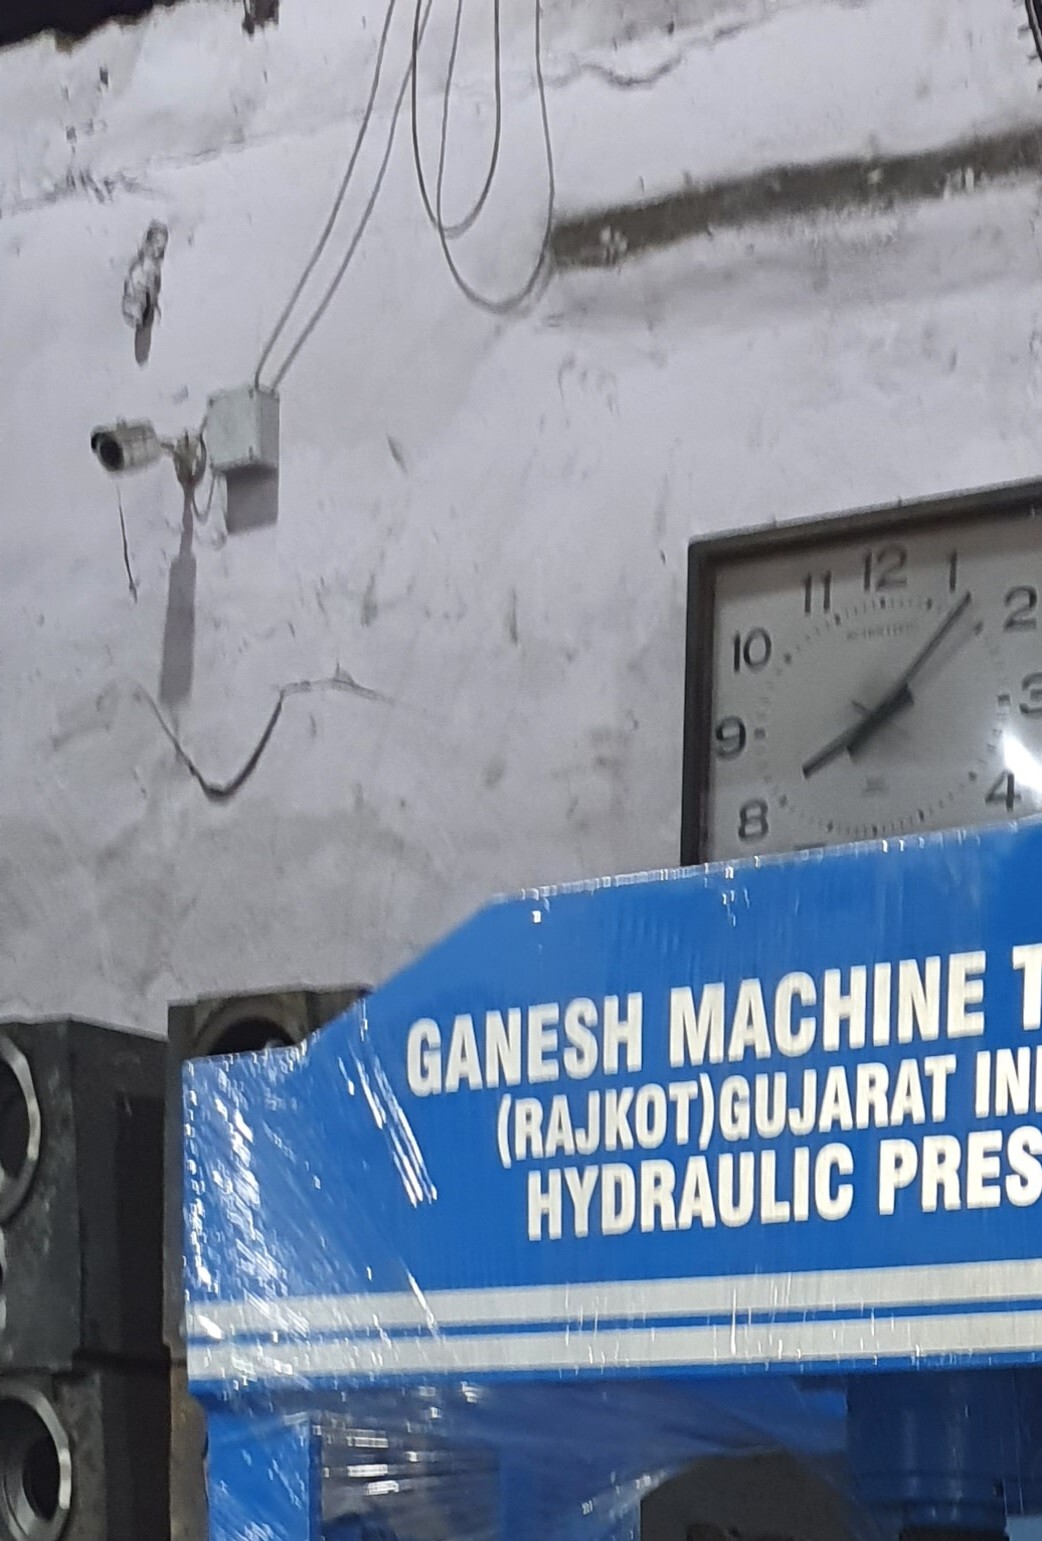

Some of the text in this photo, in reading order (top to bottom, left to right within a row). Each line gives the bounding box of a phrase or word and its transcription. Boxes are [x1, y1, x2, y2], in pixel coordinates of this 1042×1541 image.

[803, 569, 831, 614] 11
[862, 545, 908, 592] 12
[946, 549, 958, 592] 1
[1003, 585, 1038, 631] 2
[733, 627, 772, 673] 10
[715, 716, 747, 760] 9
[985, 770, 1022, 812] 4
[737, 799, 769, 842] 8
[407, 992, 643, 1097] GANESH
[669, 950, 986, 1068] MACHINE
[497, 1054, 957, 1169] (RAJKOT)GUJARAT
[527, 1142, 854, 1241] HYDRAULIC
